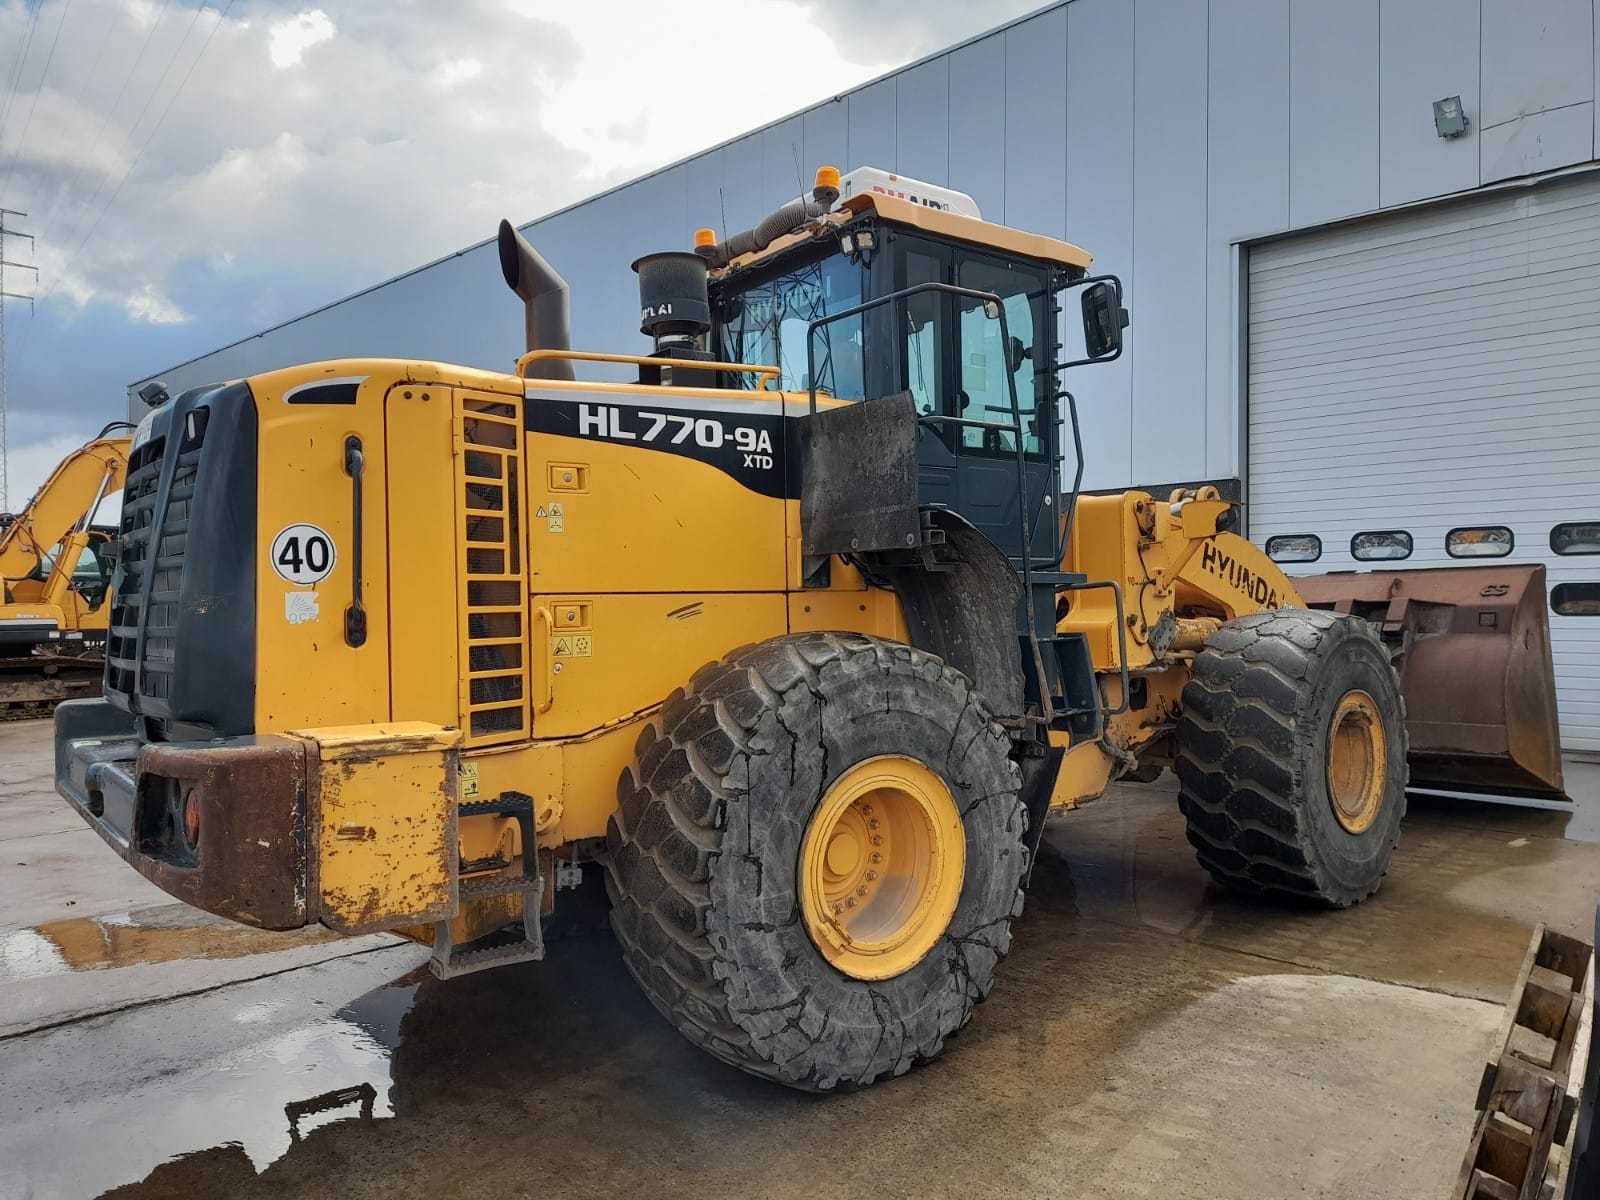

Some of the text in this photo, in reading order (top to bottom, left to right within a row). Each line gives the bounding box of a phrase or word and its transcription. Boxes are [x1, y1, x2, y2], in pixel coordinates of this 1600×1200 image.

[578, 403, 773, 454] HL770-9A
[743, 453, 773, 469] XTD
[278, 535, 329, 574] 40
